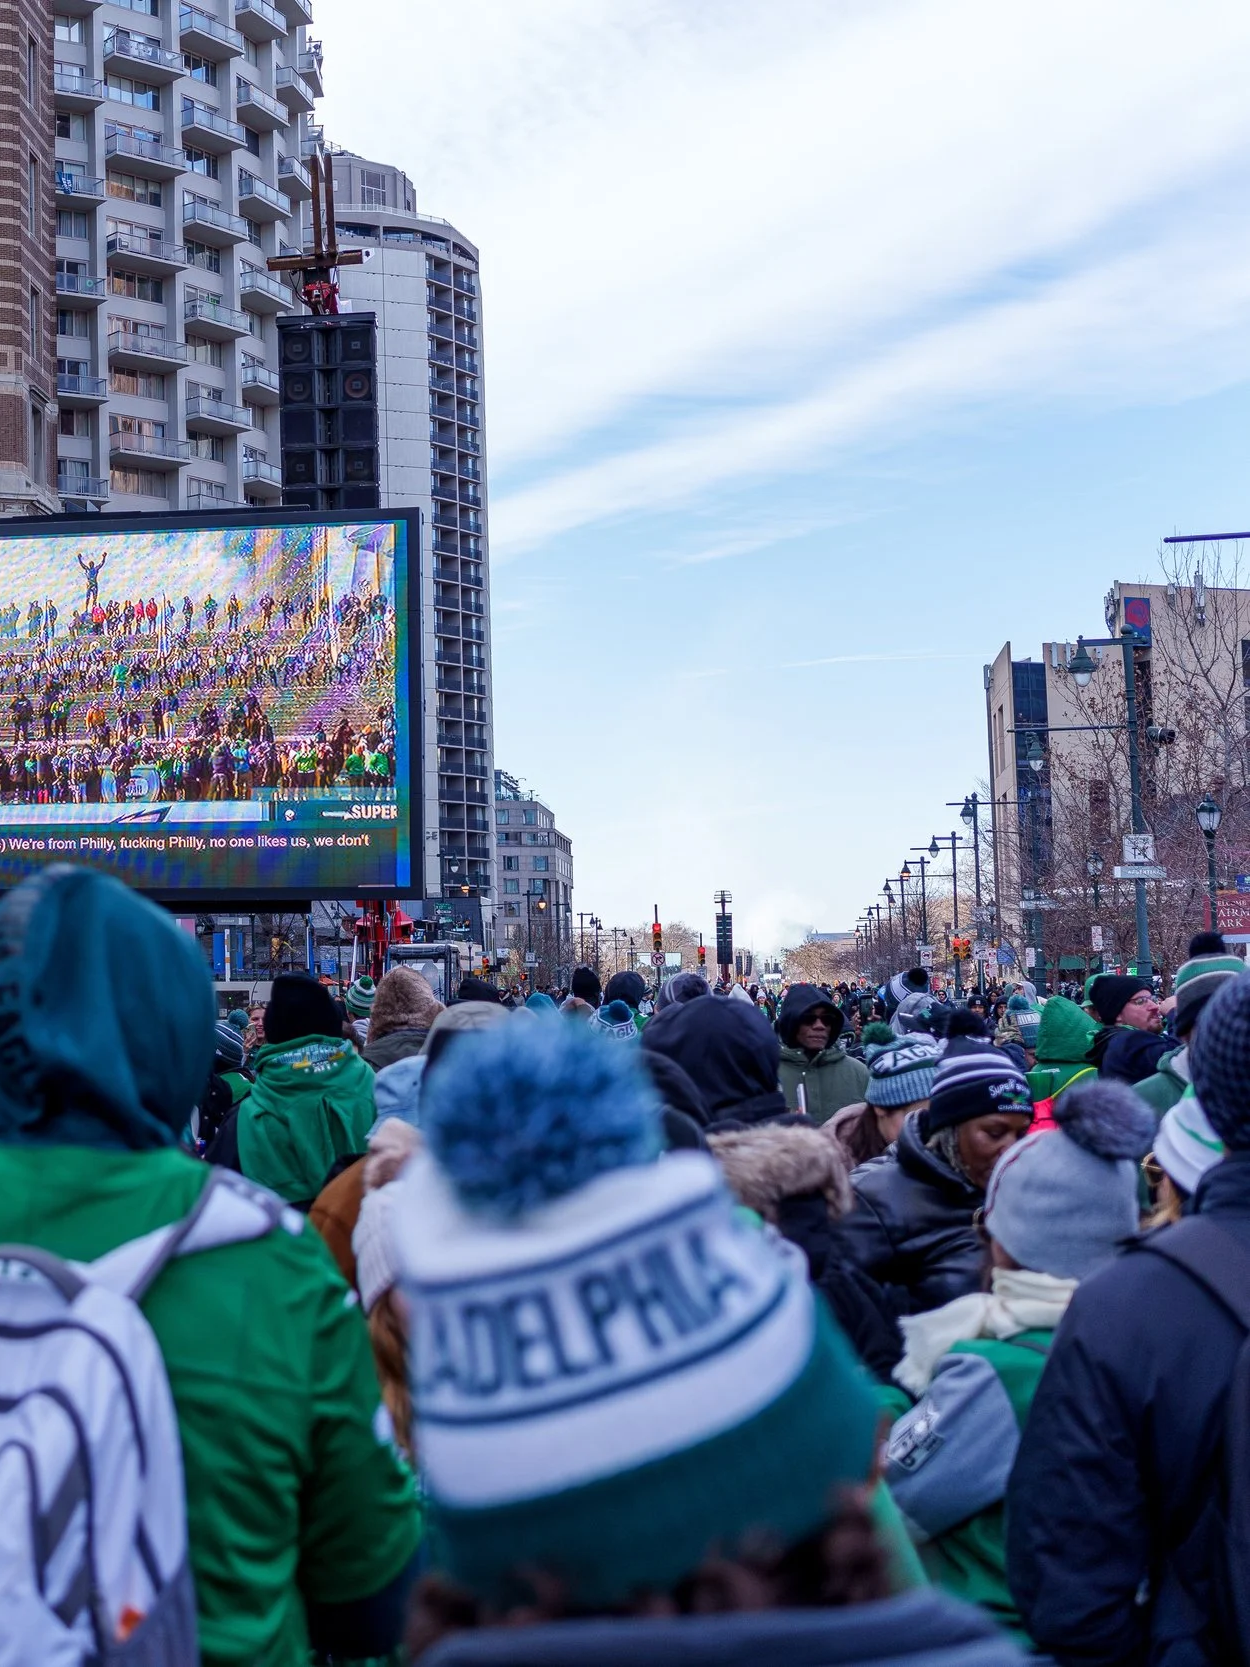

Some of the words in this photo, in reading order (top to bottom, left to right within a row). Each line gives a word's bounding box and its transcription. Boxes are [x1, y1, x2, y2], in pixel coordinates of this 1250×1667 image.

[351, 804, 398, 820] SUPER
[9, 838, 45, 850] We're
[49, 837, 77, 849] from
[80, 837, 117, 851] Philly,
[120, 836, 165, 851] fucking
[169, 836, 206, 850] Philly,
[210, 838, 227, 848] no
[229, 837, 254, 847] one
[257, 835, 288, 847] likes
[290, 836, 311, 849] us,
[314, 836, 334, 846] we
[337, 834, 370, 847] don't
[1216, 918, 1244, 928] ARK
